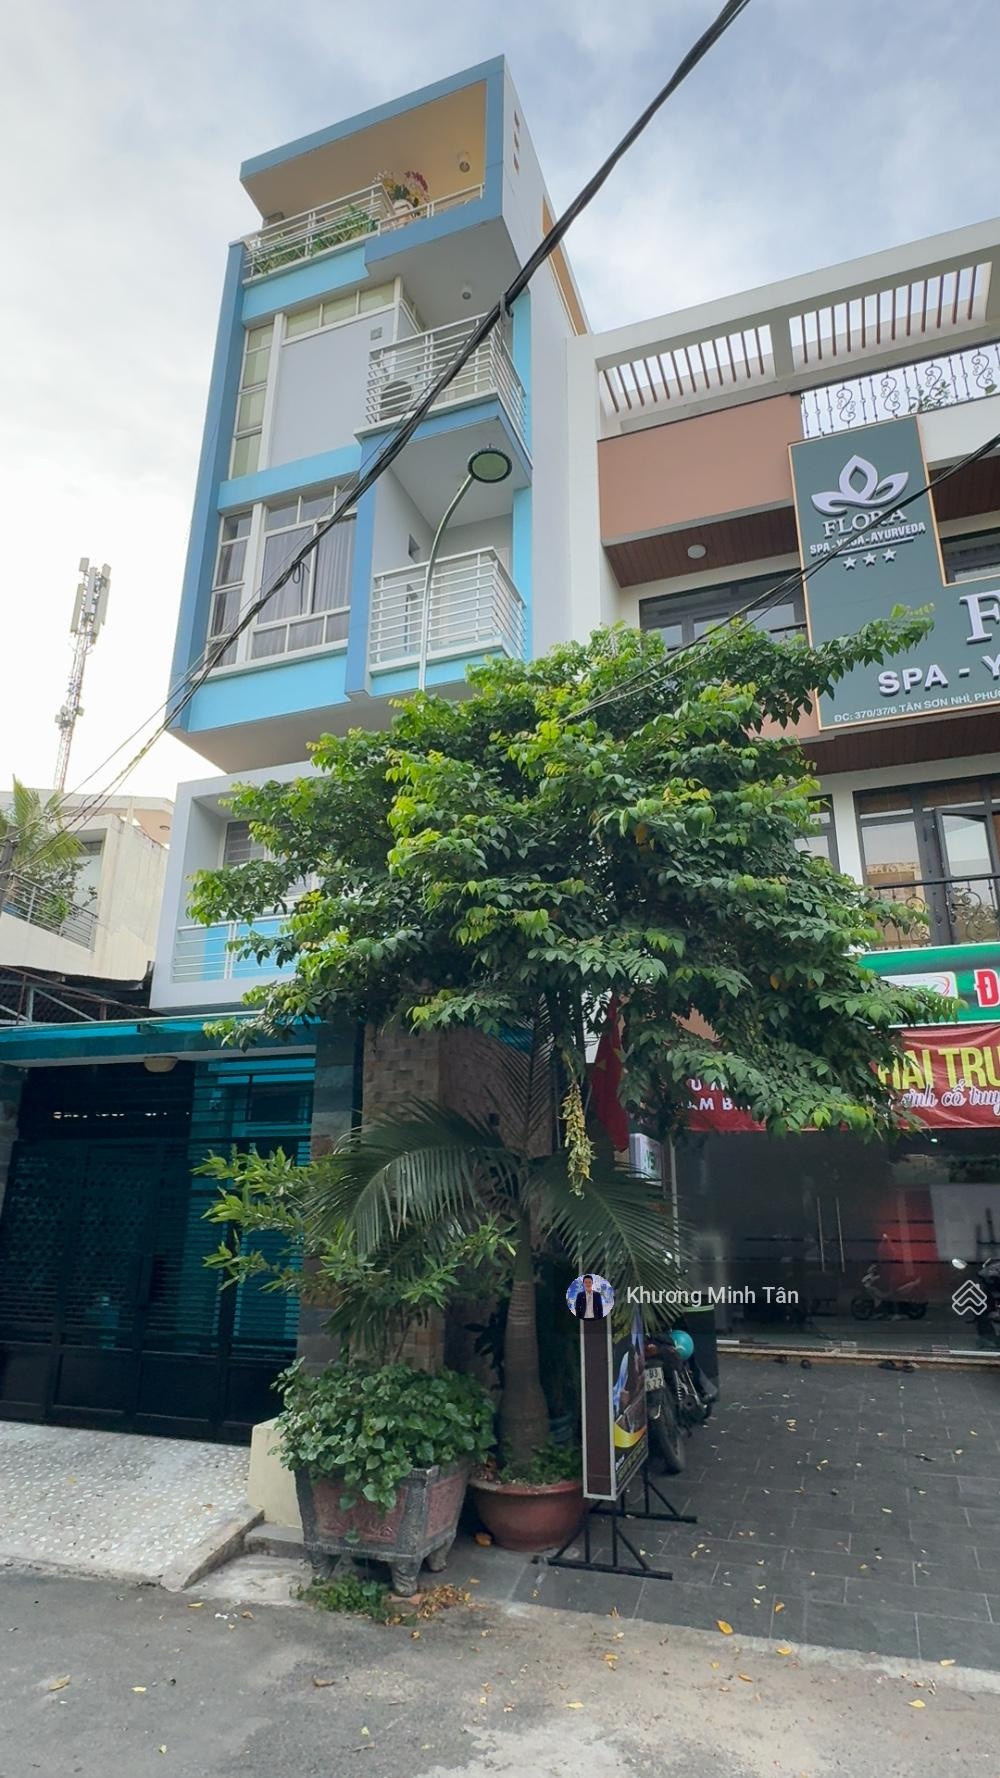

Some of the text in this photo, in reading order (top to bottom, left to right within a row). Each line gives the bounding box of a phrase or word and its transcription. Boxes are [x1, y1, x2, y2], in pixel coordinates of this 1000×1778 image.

[878, 664, 949, 697] SPA
[854, 706, 898, 720] 370/37/6
[923, 697, 948, 709] SƠN
